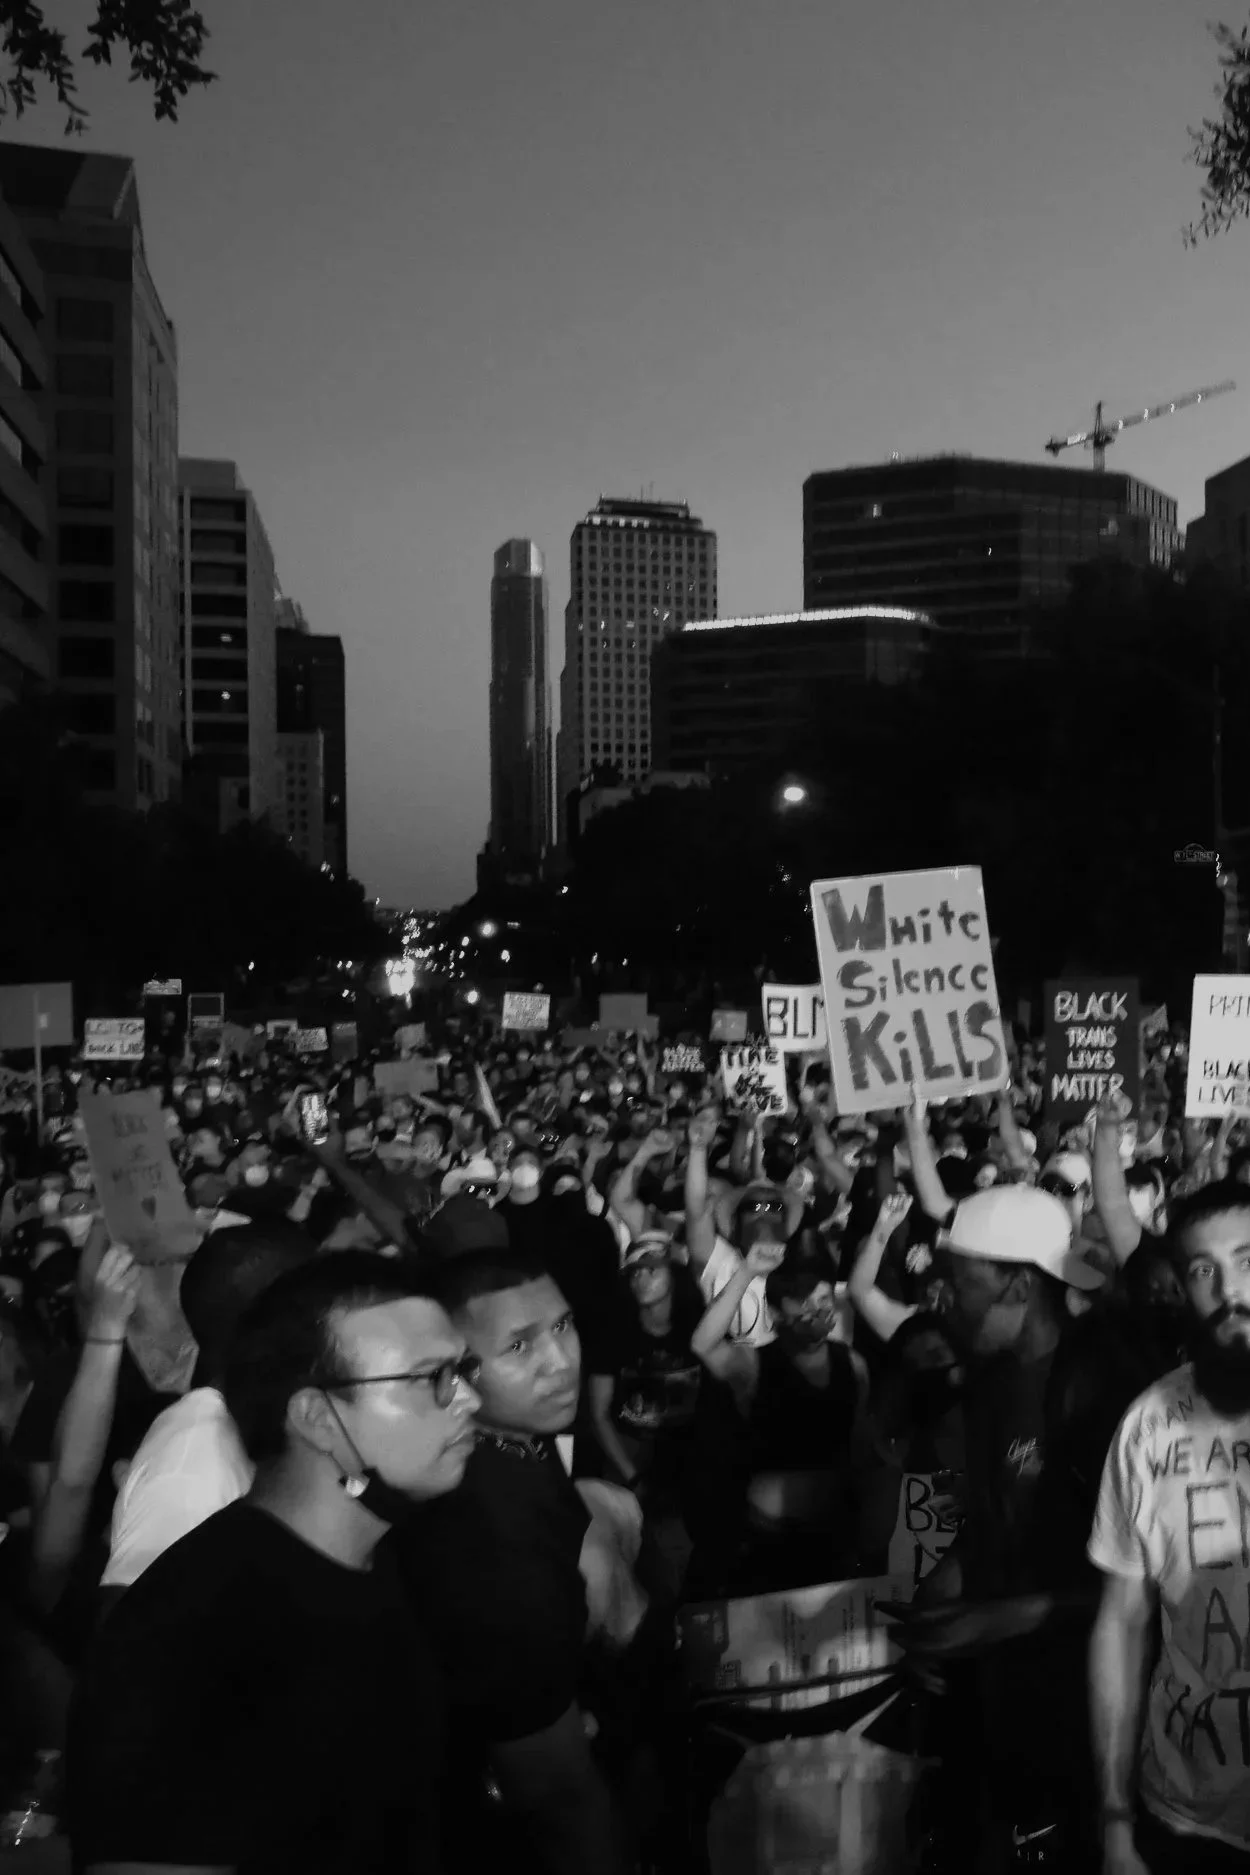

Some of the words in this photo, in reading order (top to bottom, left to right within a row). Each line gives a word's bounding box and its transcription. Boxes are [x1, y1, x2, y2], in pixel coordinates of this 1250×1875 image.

[1054, 991, 1128, 1023] BLACK
[1066, 1026, 1118, 1050] TRANS
[1066, 1050, 1116, 1070] LIVES
[1051, 1073, 1125, 1103] MATTER
[1146, 1438, 1191, 1482] WE
